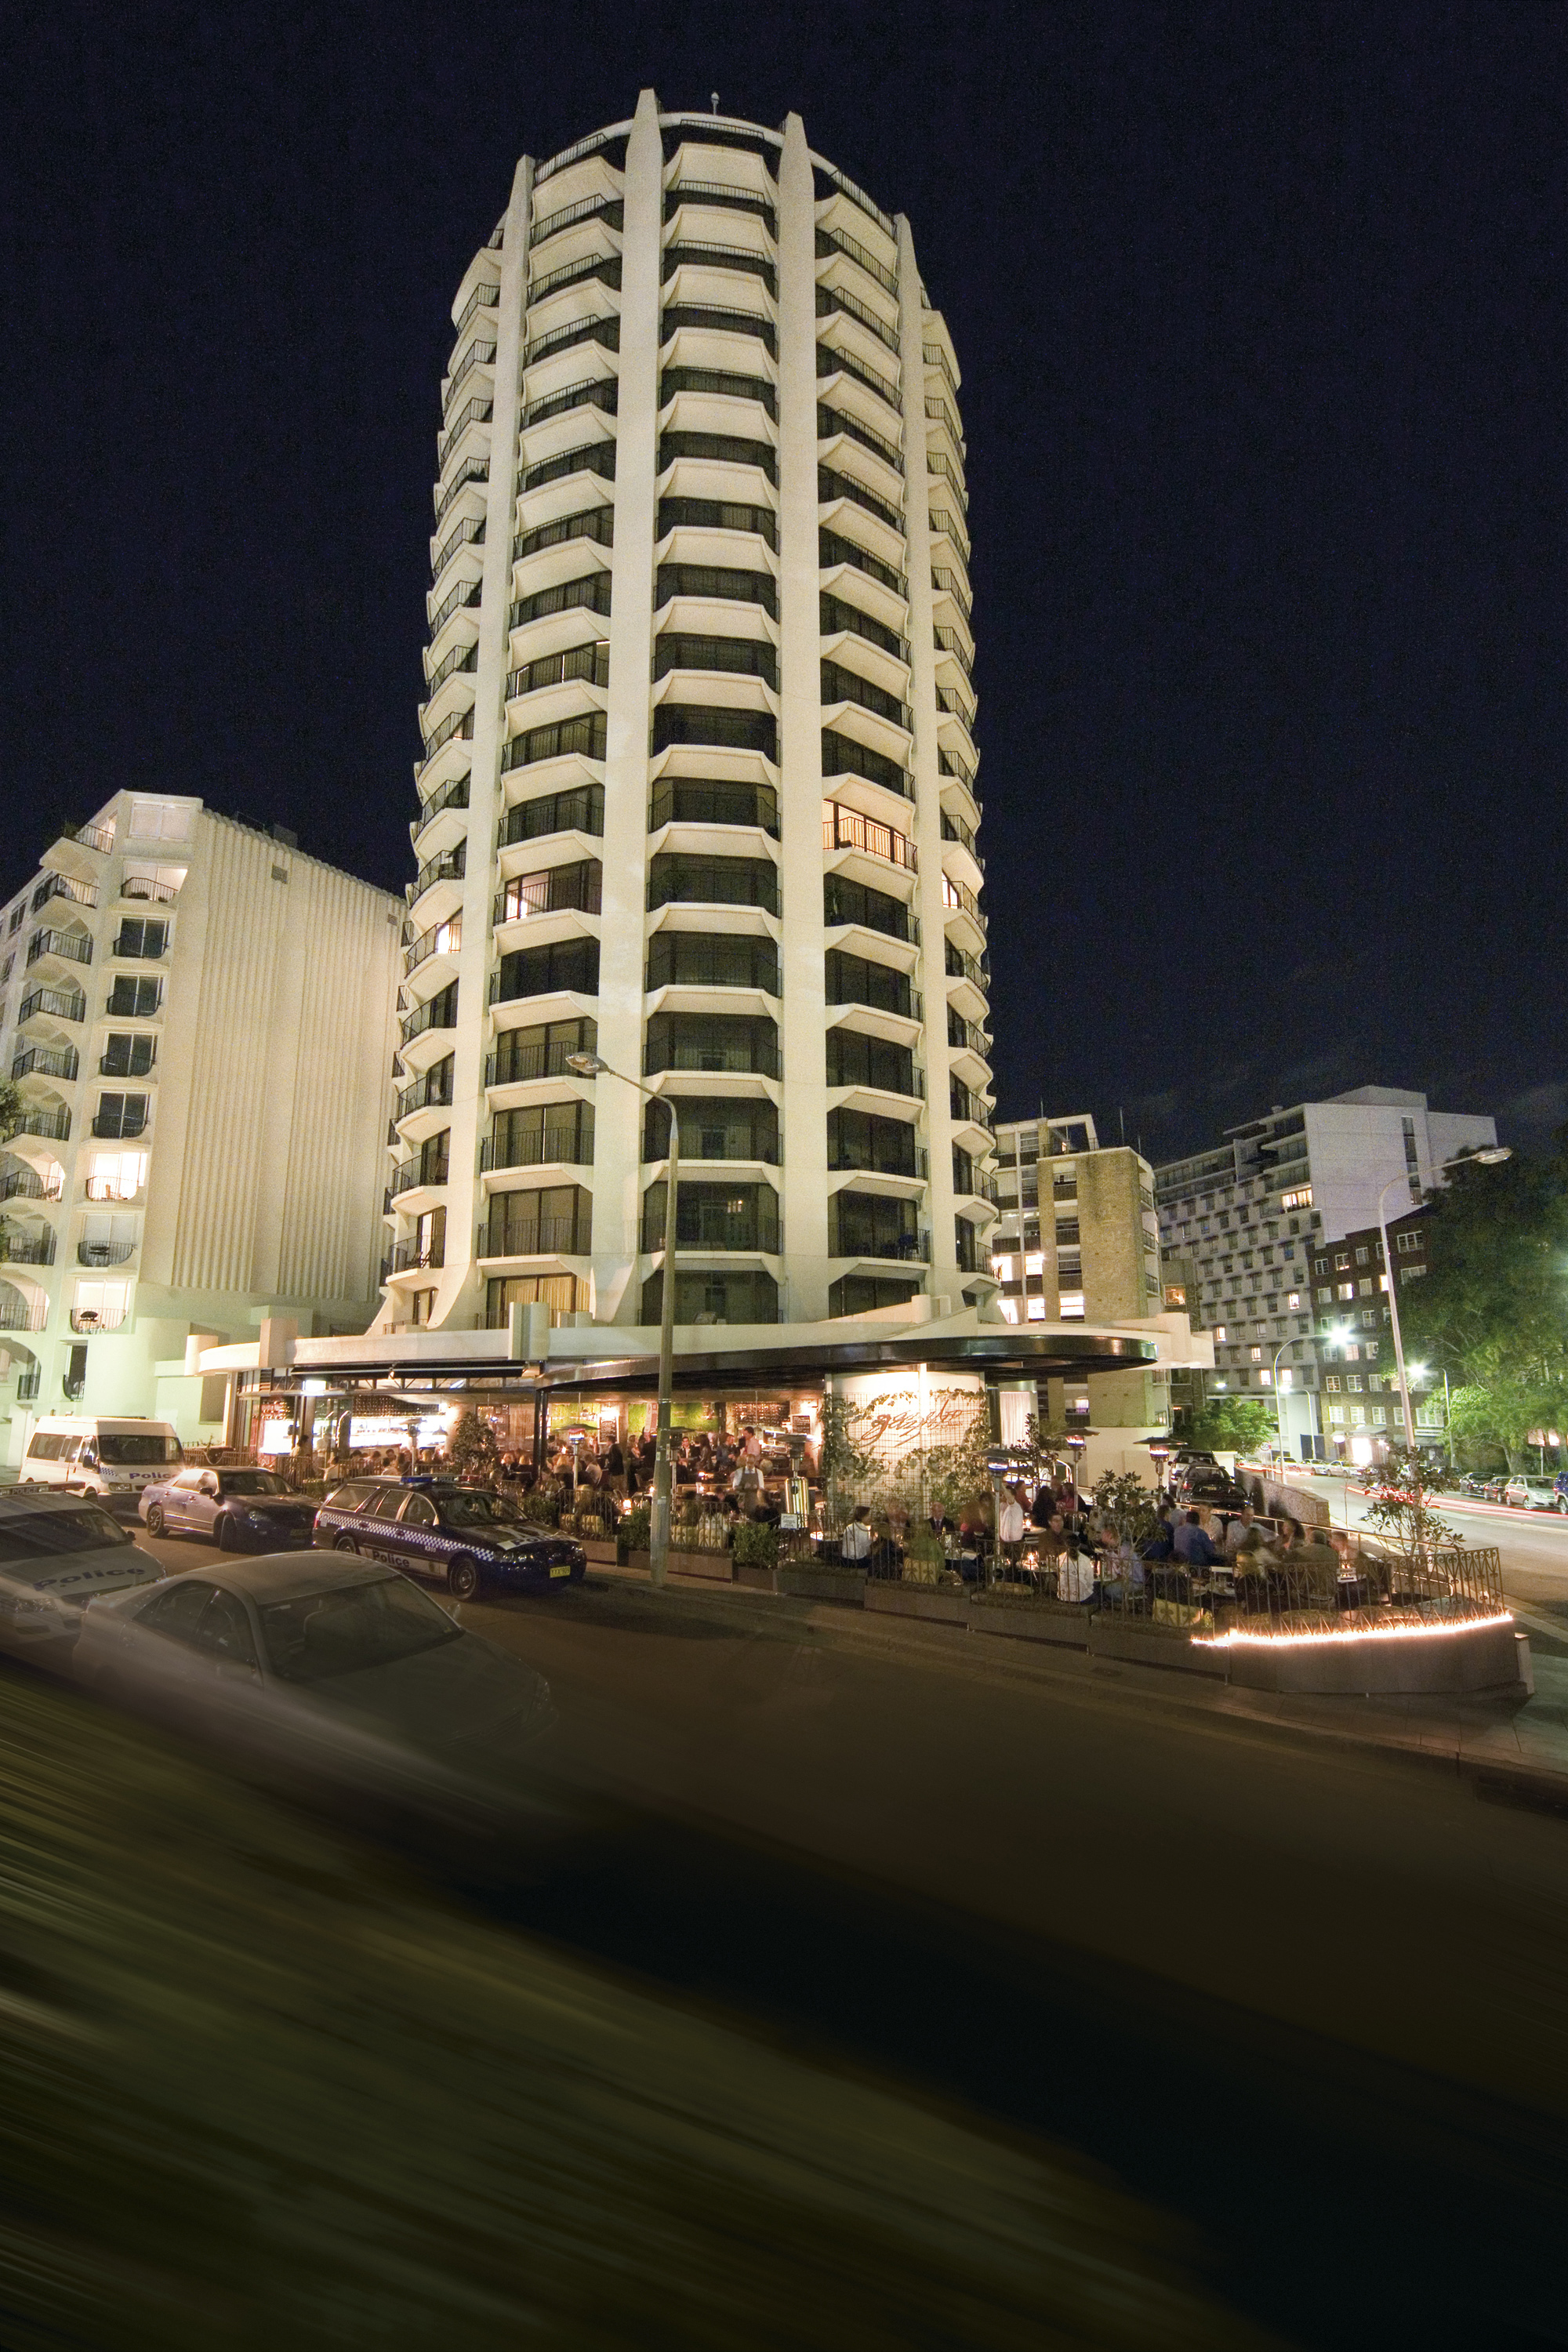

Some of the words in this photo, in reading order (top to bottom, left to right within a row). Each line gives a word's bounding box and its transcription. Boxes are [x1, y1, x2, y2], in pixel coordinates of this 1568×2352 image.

[12, 1486, 38, 1495] POLICE
[372, 1549, 410, 1567] Police
[32, 1568, 145, 1592] Police
